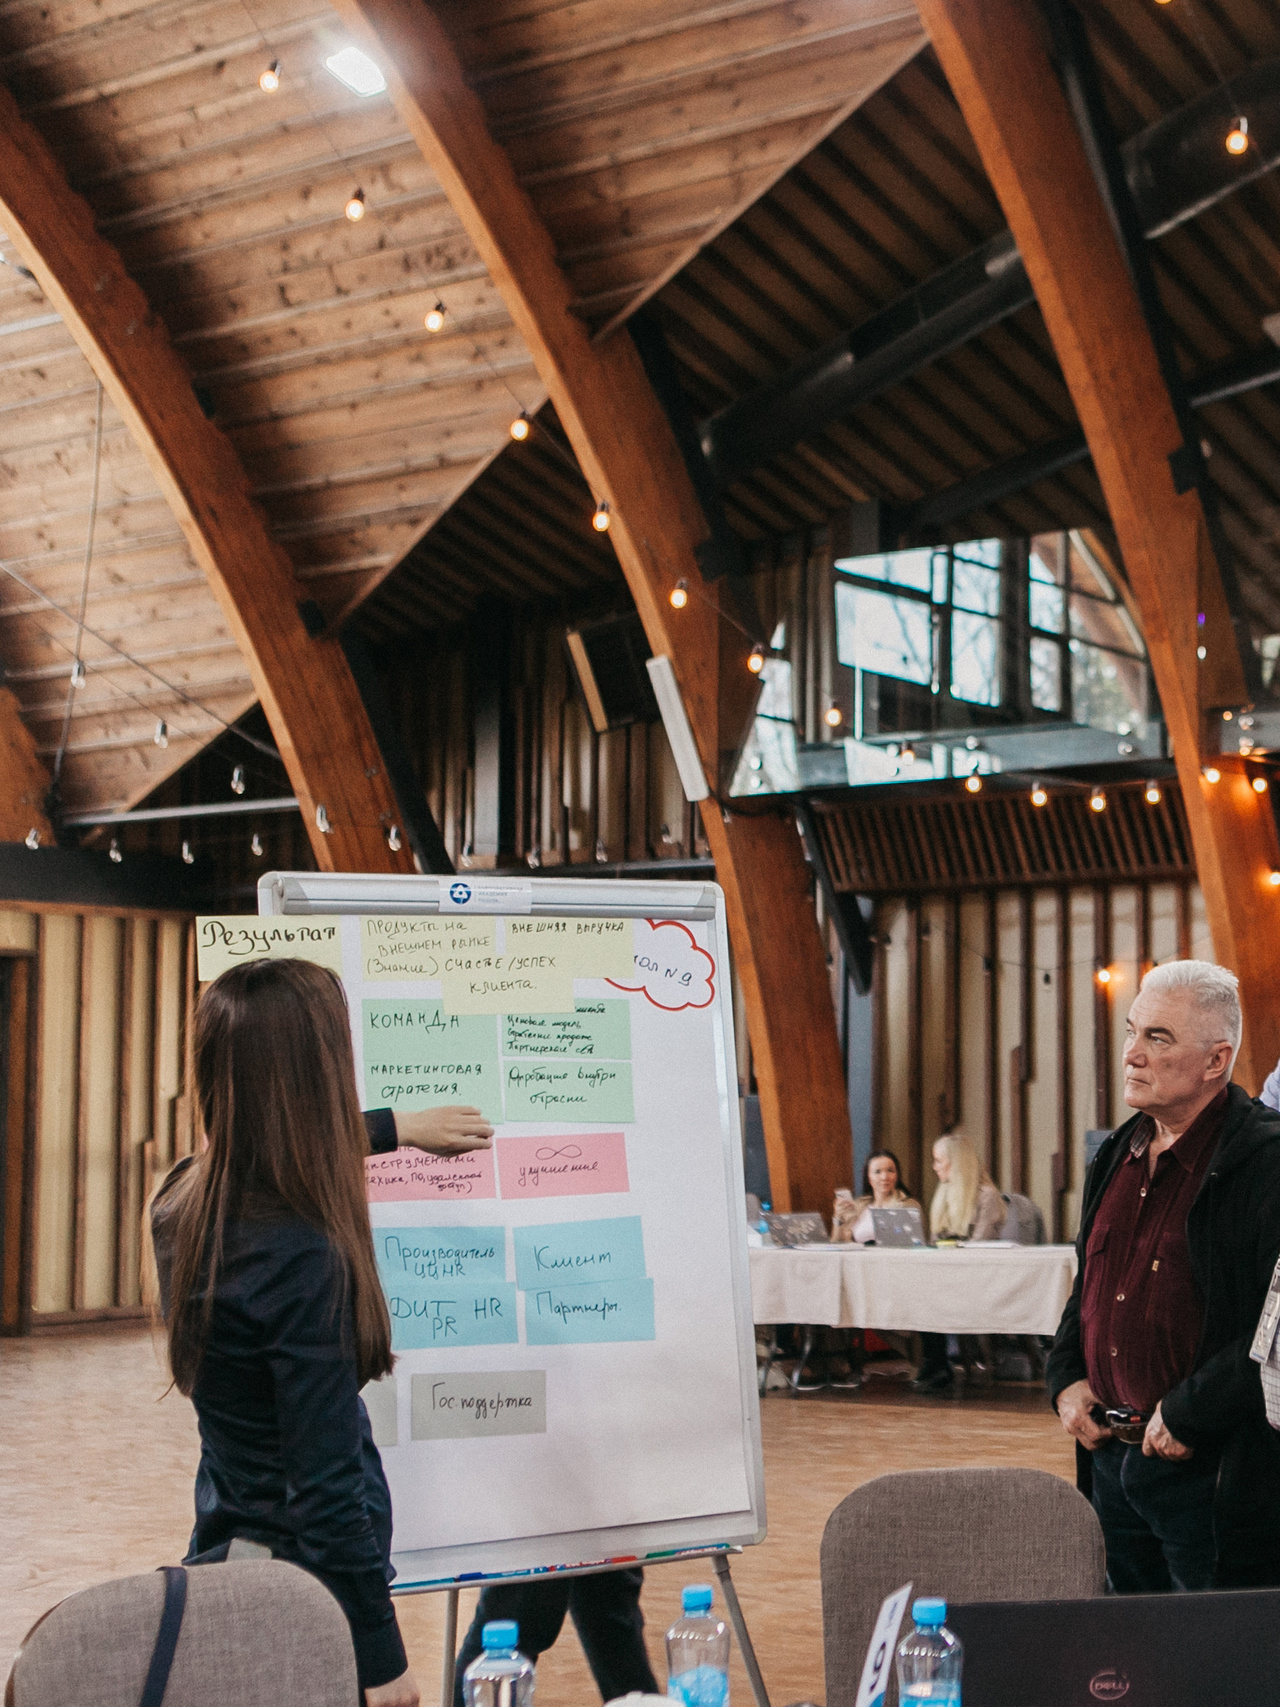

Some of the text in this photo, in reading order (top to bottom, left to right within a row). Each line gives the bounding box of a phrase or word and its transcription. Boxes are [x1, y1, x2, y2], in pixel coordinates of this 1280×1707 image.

[202, 920, 336, 956] Результат
[512, 921, 567, 934] ВНЕШНЯЯ
[370, 1063, 483, 1076] МАРКЕТИНГОВАЯ
[384, 1235, 495, 1271] Производитель
[533, 1245, 612, 1272] Клиент
